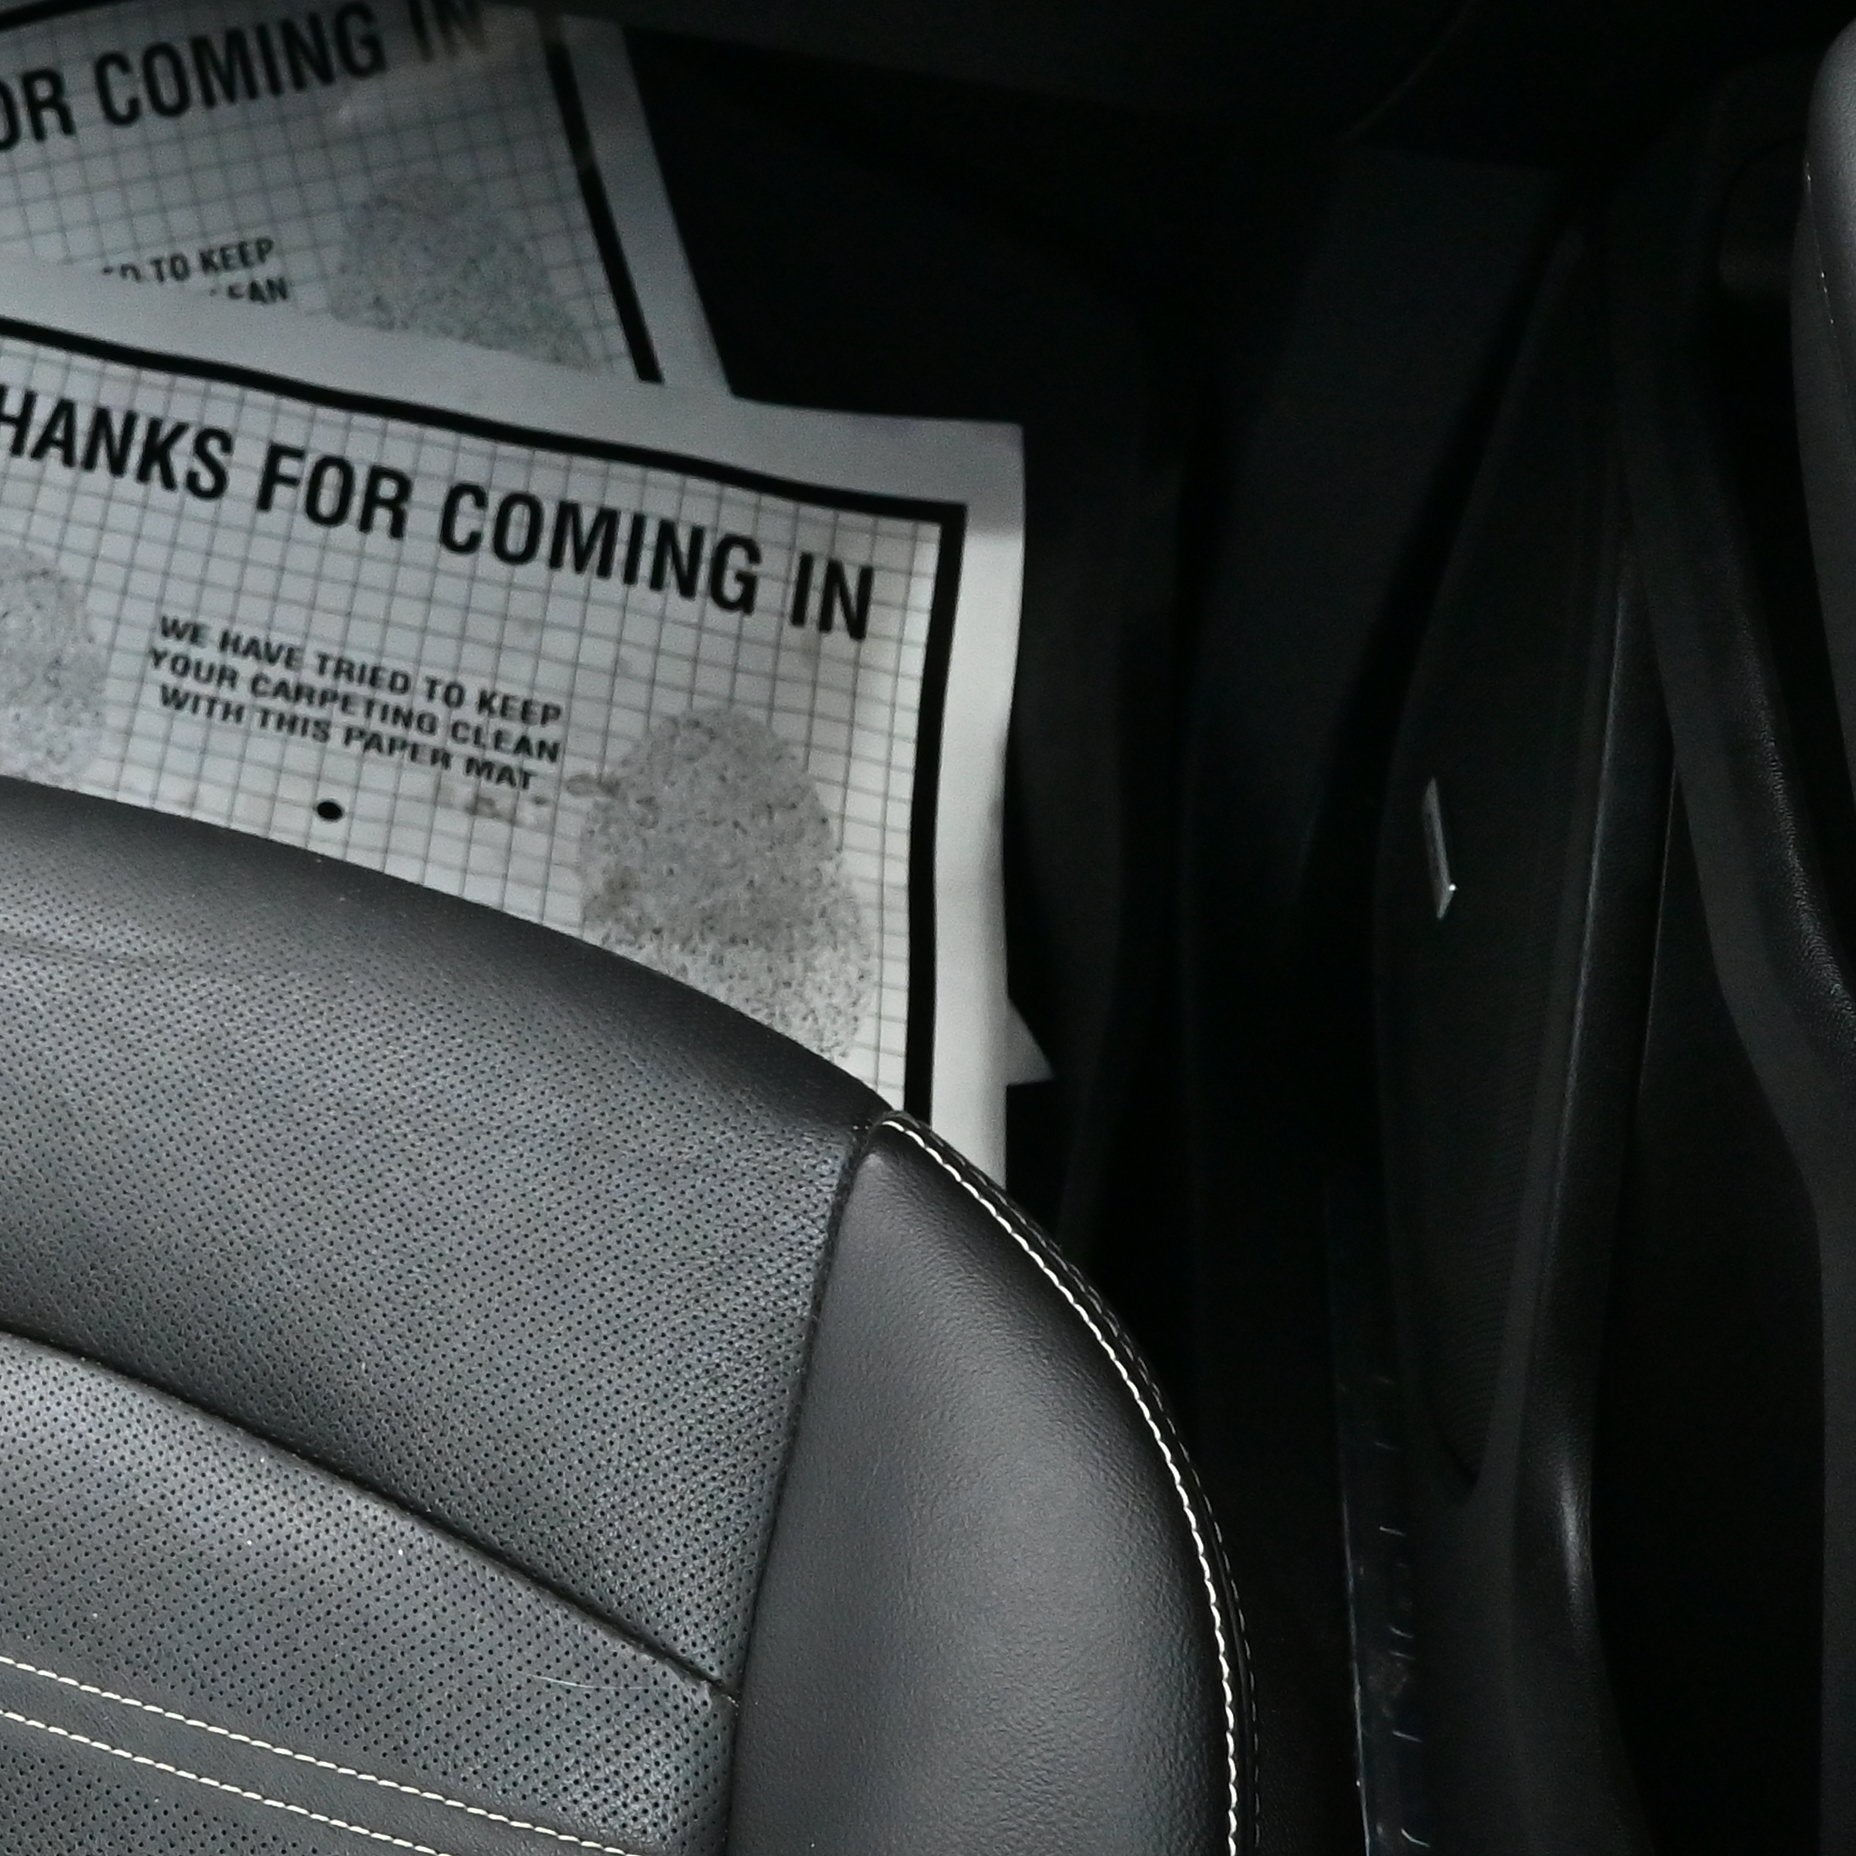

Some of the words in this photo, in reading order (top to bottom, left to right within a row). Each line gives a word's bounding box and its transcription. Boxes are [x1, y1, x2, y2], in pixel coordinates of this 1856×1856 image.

[93, 0, 388, 127] COMING
[151, 254, 189, 283] TO
[199, 238, 275, 276] KEEP
[256, 440, 412, 540] FOR
[440, 482, 762, 615] COMING
[790, 551, 875, 641] IN
[149, 646, 239, 692] YOUR
[250, 670, 438, 738] CARPETING
[451, 721, 560, 763] CLEAN
[159, 615, 212, 646] WE
[218, 628, 305, 671] HAVE
[315, 650, 412, 696] TRIED
[424, 675, 466, 710] TO
[477, 688, 562, 729] KEEP
[159, 683, 245, 724] WITH
[258, 707, 332, 744] THIS
[344, 724, 451, 771] PAPER
[465, 755, 538, 790] MAT
